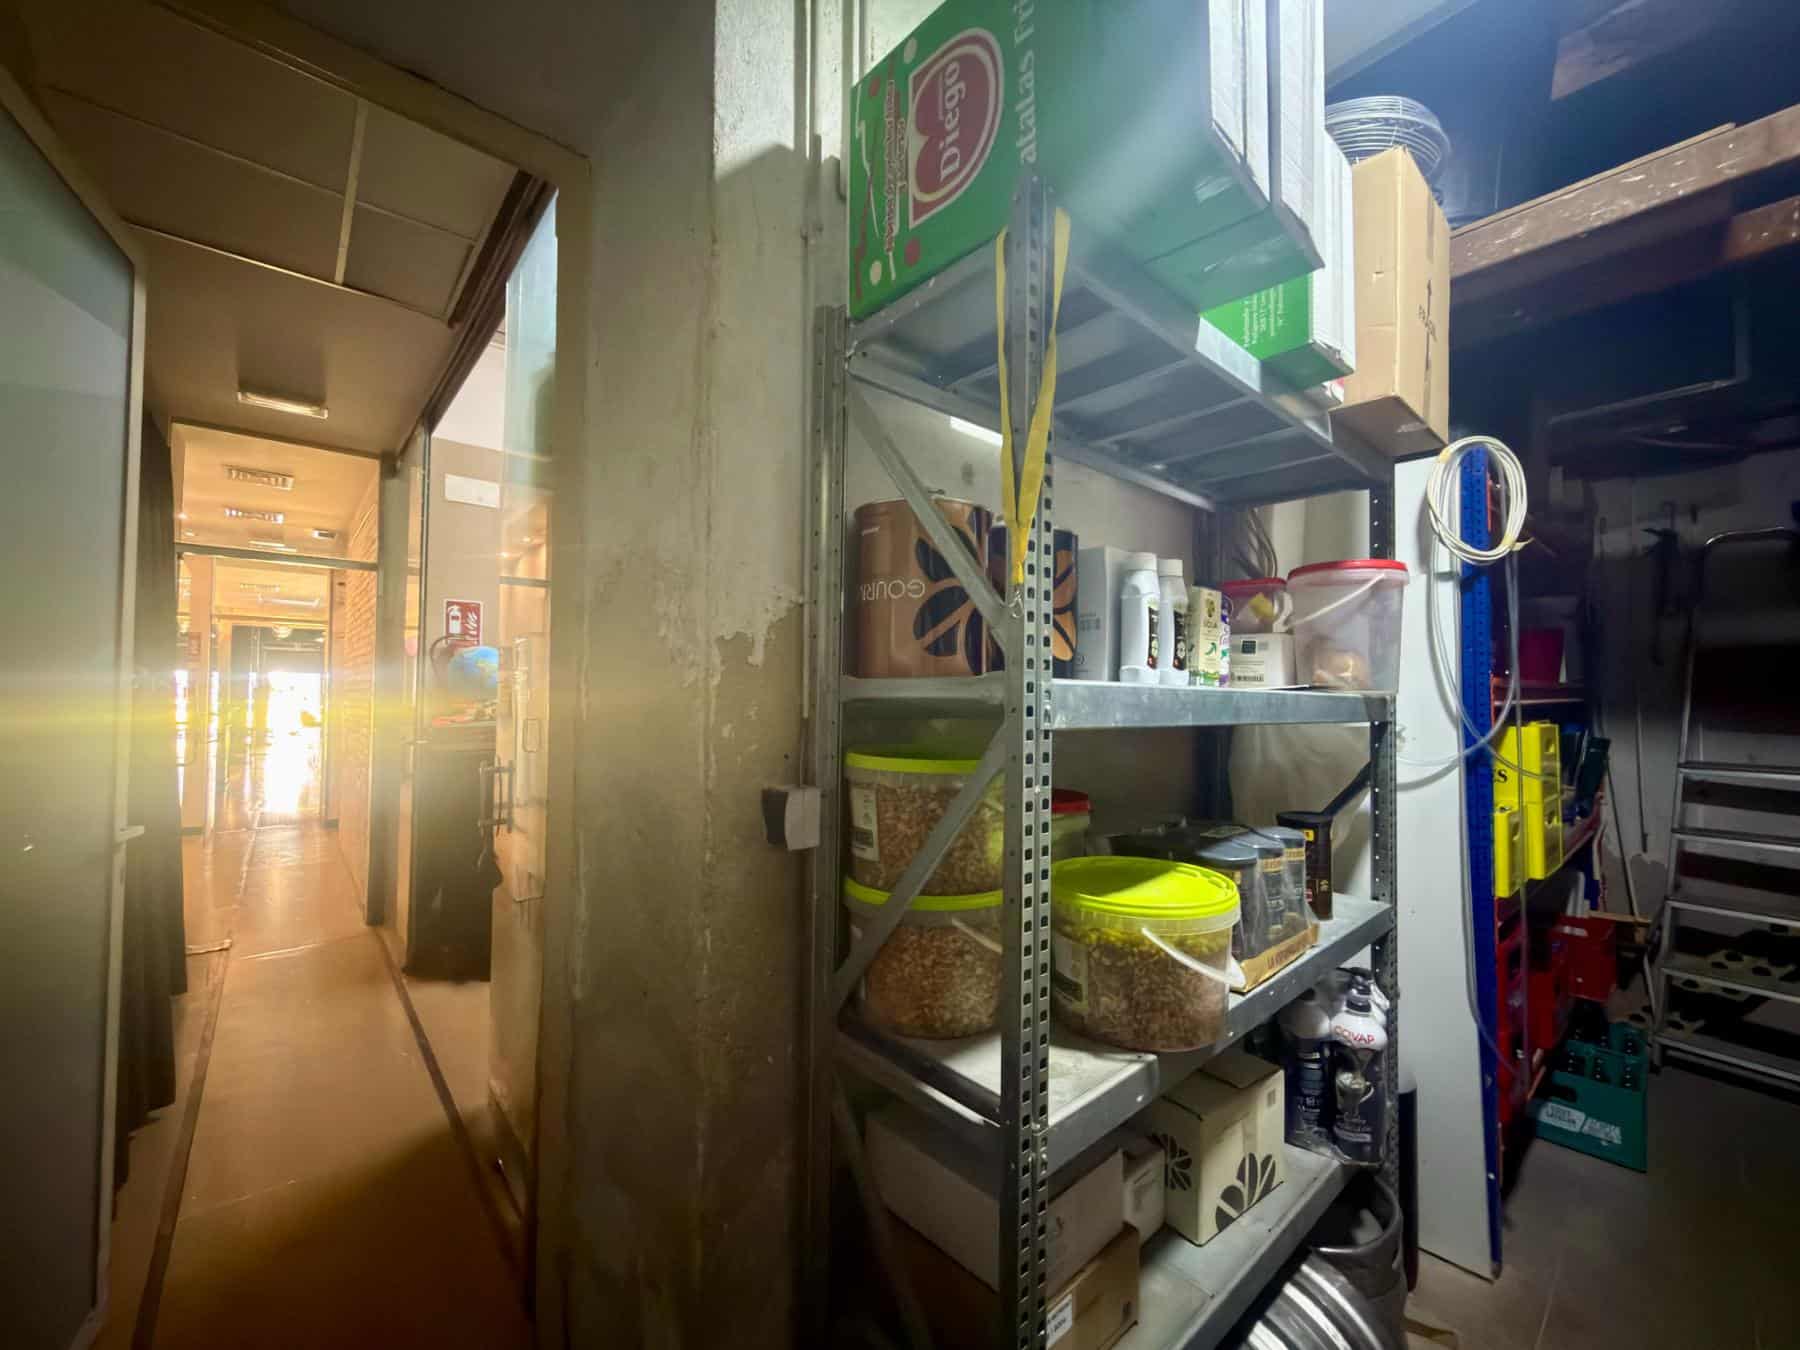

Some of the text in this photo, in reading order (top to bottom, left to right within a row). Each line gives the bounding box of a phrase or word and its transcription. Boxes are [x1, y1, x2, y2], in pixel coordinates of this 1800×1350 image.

[939, 61, 966, 182] Diego
[1016, 51, 1036, 165] atatas
[1334, 1025, 1375, 1045] COVAP
